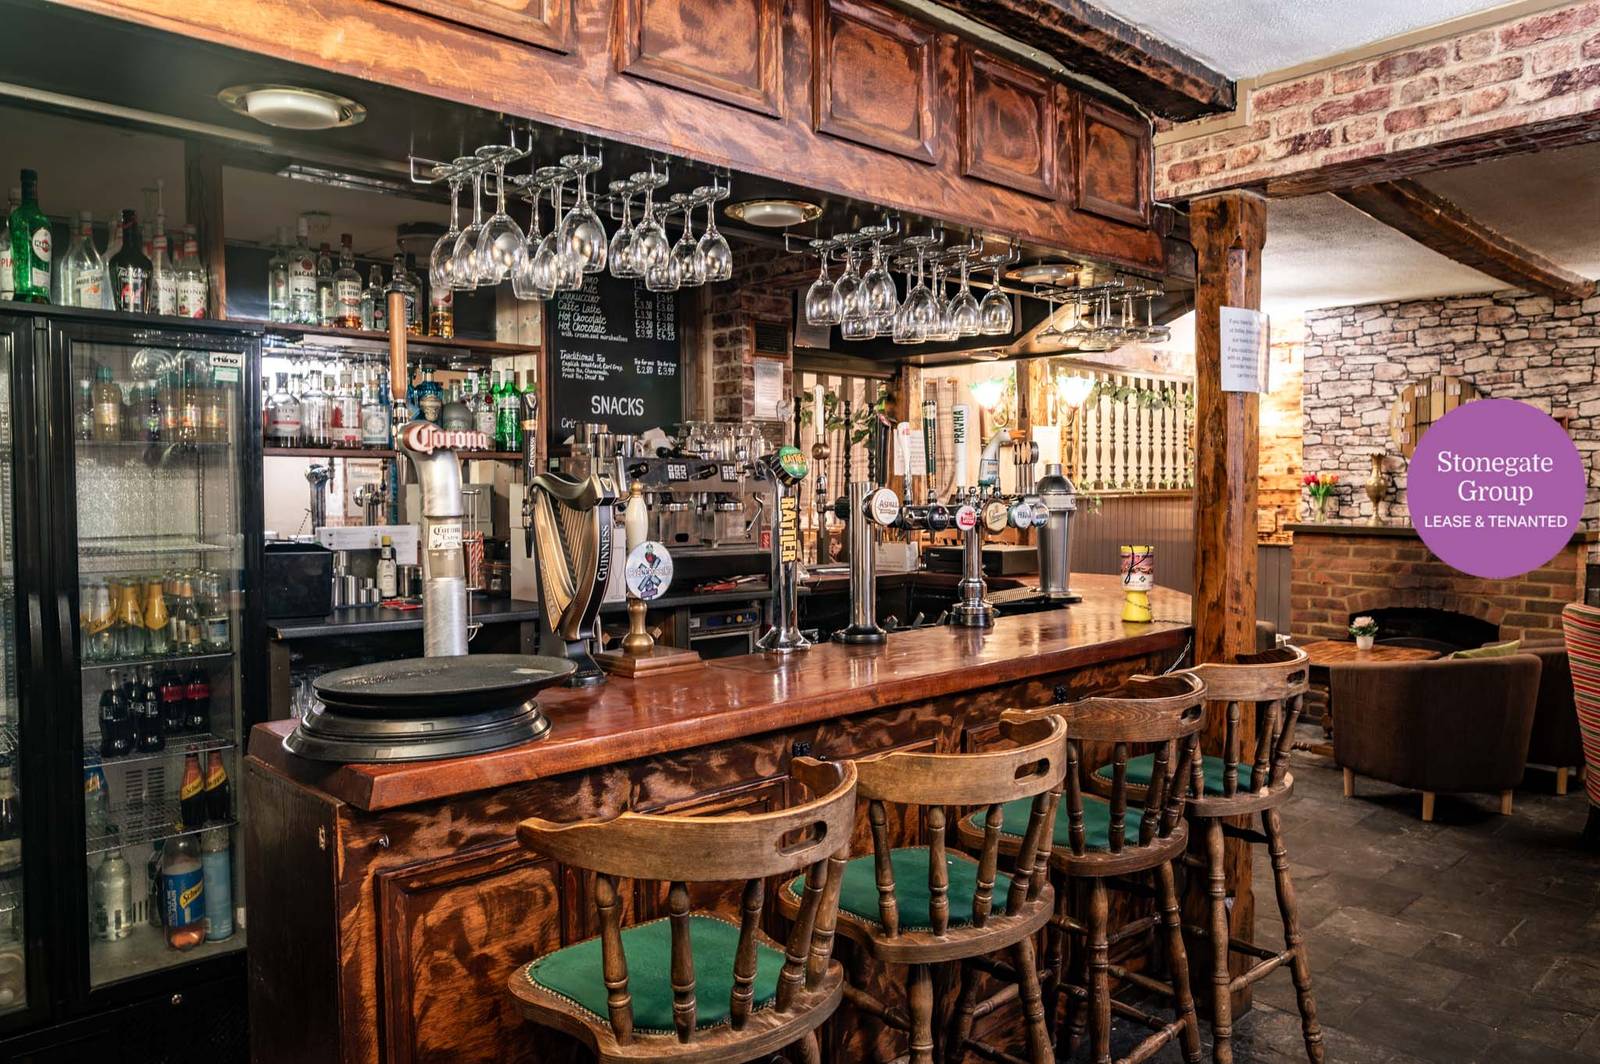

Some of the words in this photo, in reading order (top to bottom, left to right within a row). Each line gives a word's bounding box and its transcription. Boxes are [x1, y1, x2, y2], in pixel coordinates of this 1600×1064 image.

[558, 311, 571, 321] Hot
[572, 312, 607, 325] Chocolate
[558, 321, 571, 331] Hot
[572, 322, 607, 334] Chocolate
[560, 350, 594, 361] Traditional
[596, 353, 606, 362] Tea
[591, 395, 644, 416] SNACKS
[408, 423, 488, 455] Corona
[781, 496, 797, 563] RATTLER
[597, 524, 610, 581] GUINNESS
